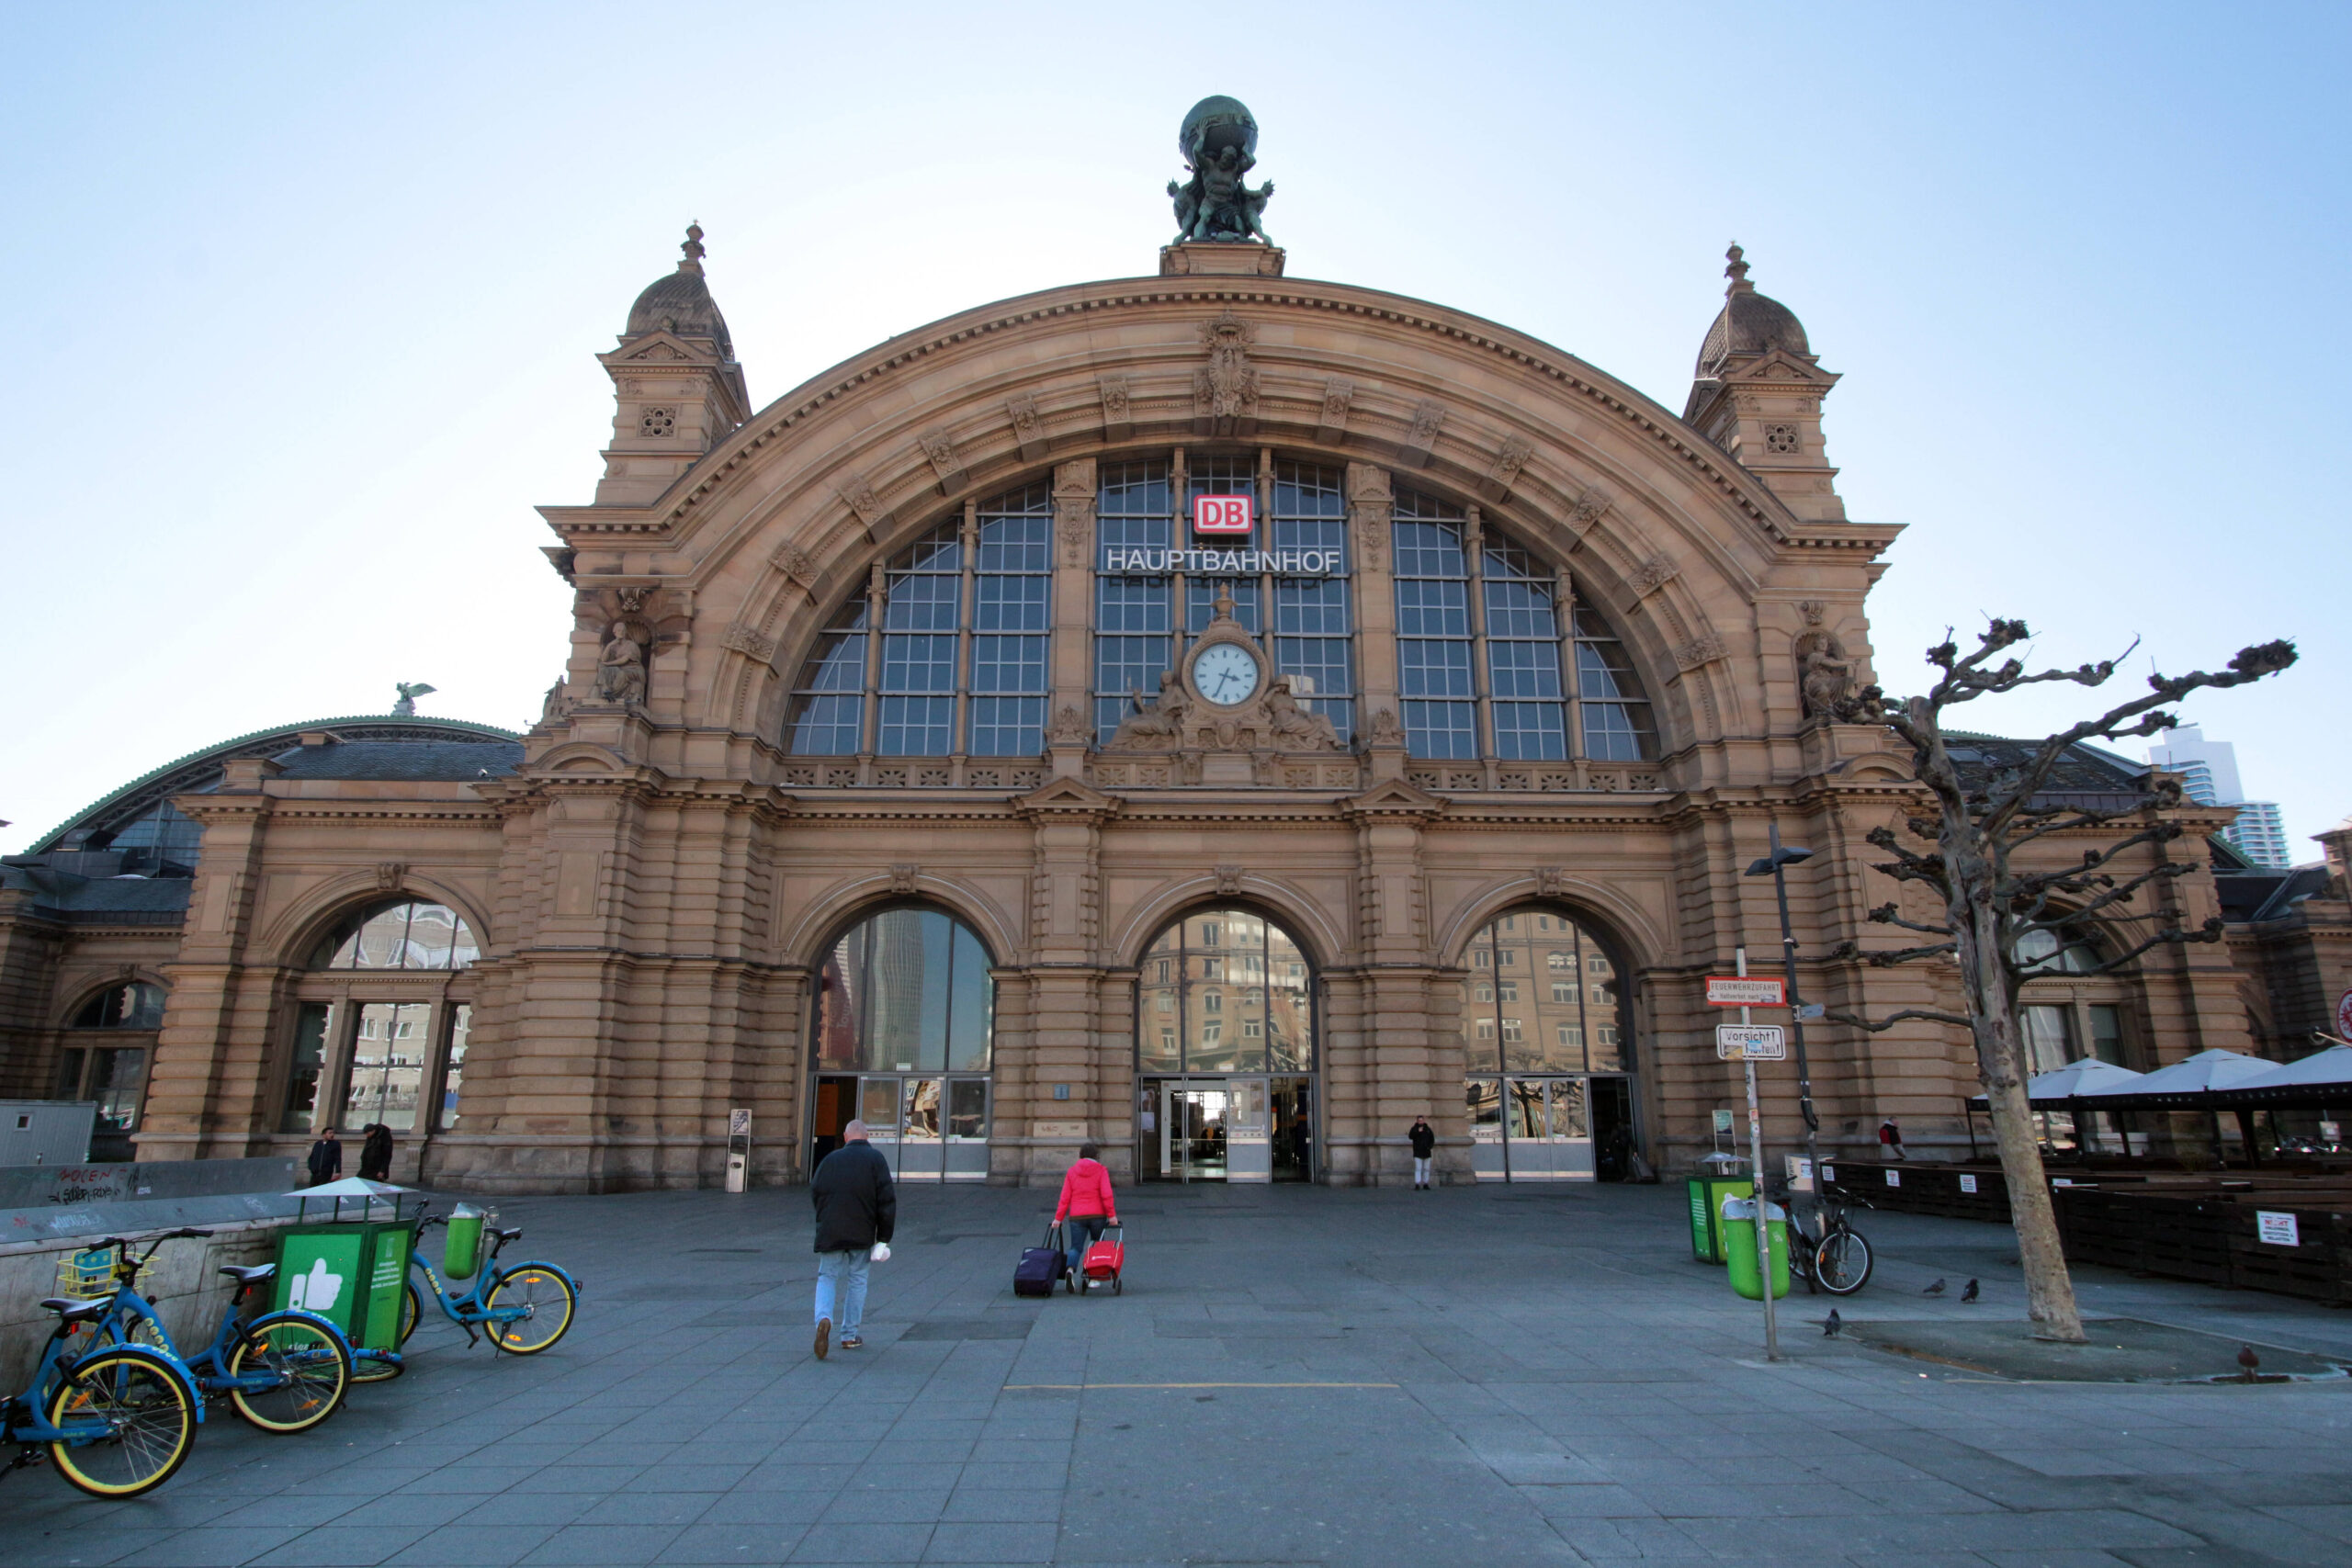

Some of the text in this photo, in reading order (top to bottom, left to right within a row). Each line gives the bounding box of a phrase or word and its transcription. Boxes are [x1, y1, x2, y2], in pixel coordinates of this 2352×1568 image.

[1202, 501, 1244, 526] DB
[1107, 548, 1340, 572] HAUPTBAHNHOF
[1711, 982, 1780, 991] FEUERWEHRZUFAHRT
[1725, 1030, 1775, 1042] Vorsicht!
